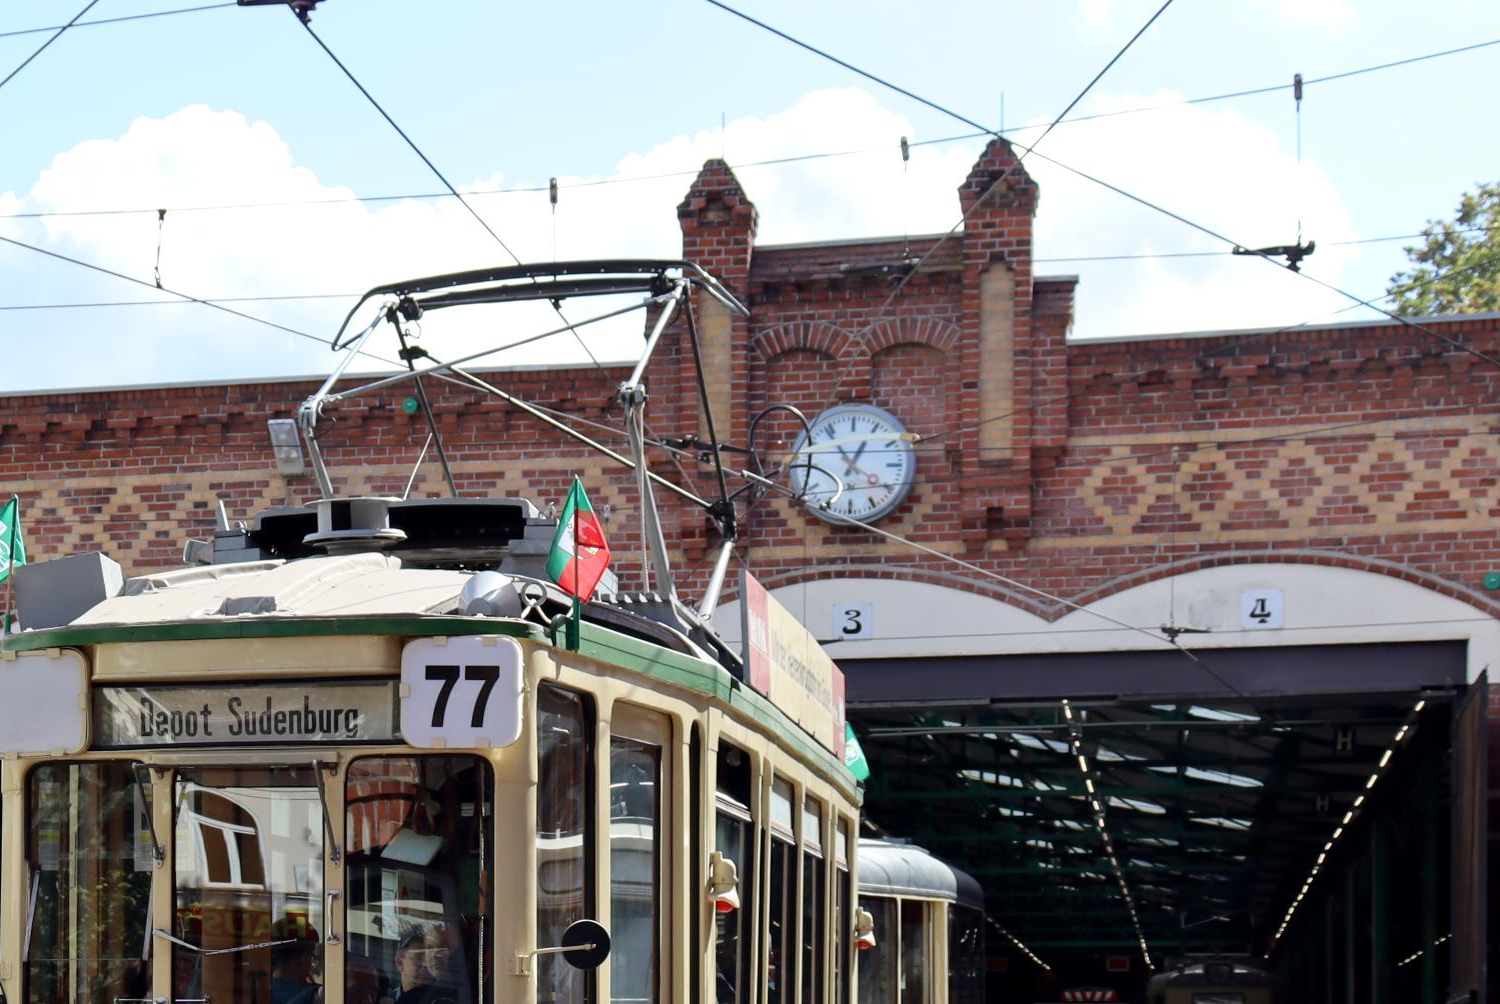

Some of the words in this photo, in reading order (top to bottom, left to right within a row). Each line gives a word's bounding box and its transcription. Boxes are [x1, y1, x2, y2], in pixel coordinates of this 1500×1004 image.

[842, 609, 862, 635] 3
[1249, 597, 1271, 624] 4
[424, 665, 501, 728] 77
[139, 696, 212, 738] Depot
[228, 695, 360, 739] Sudenburg
